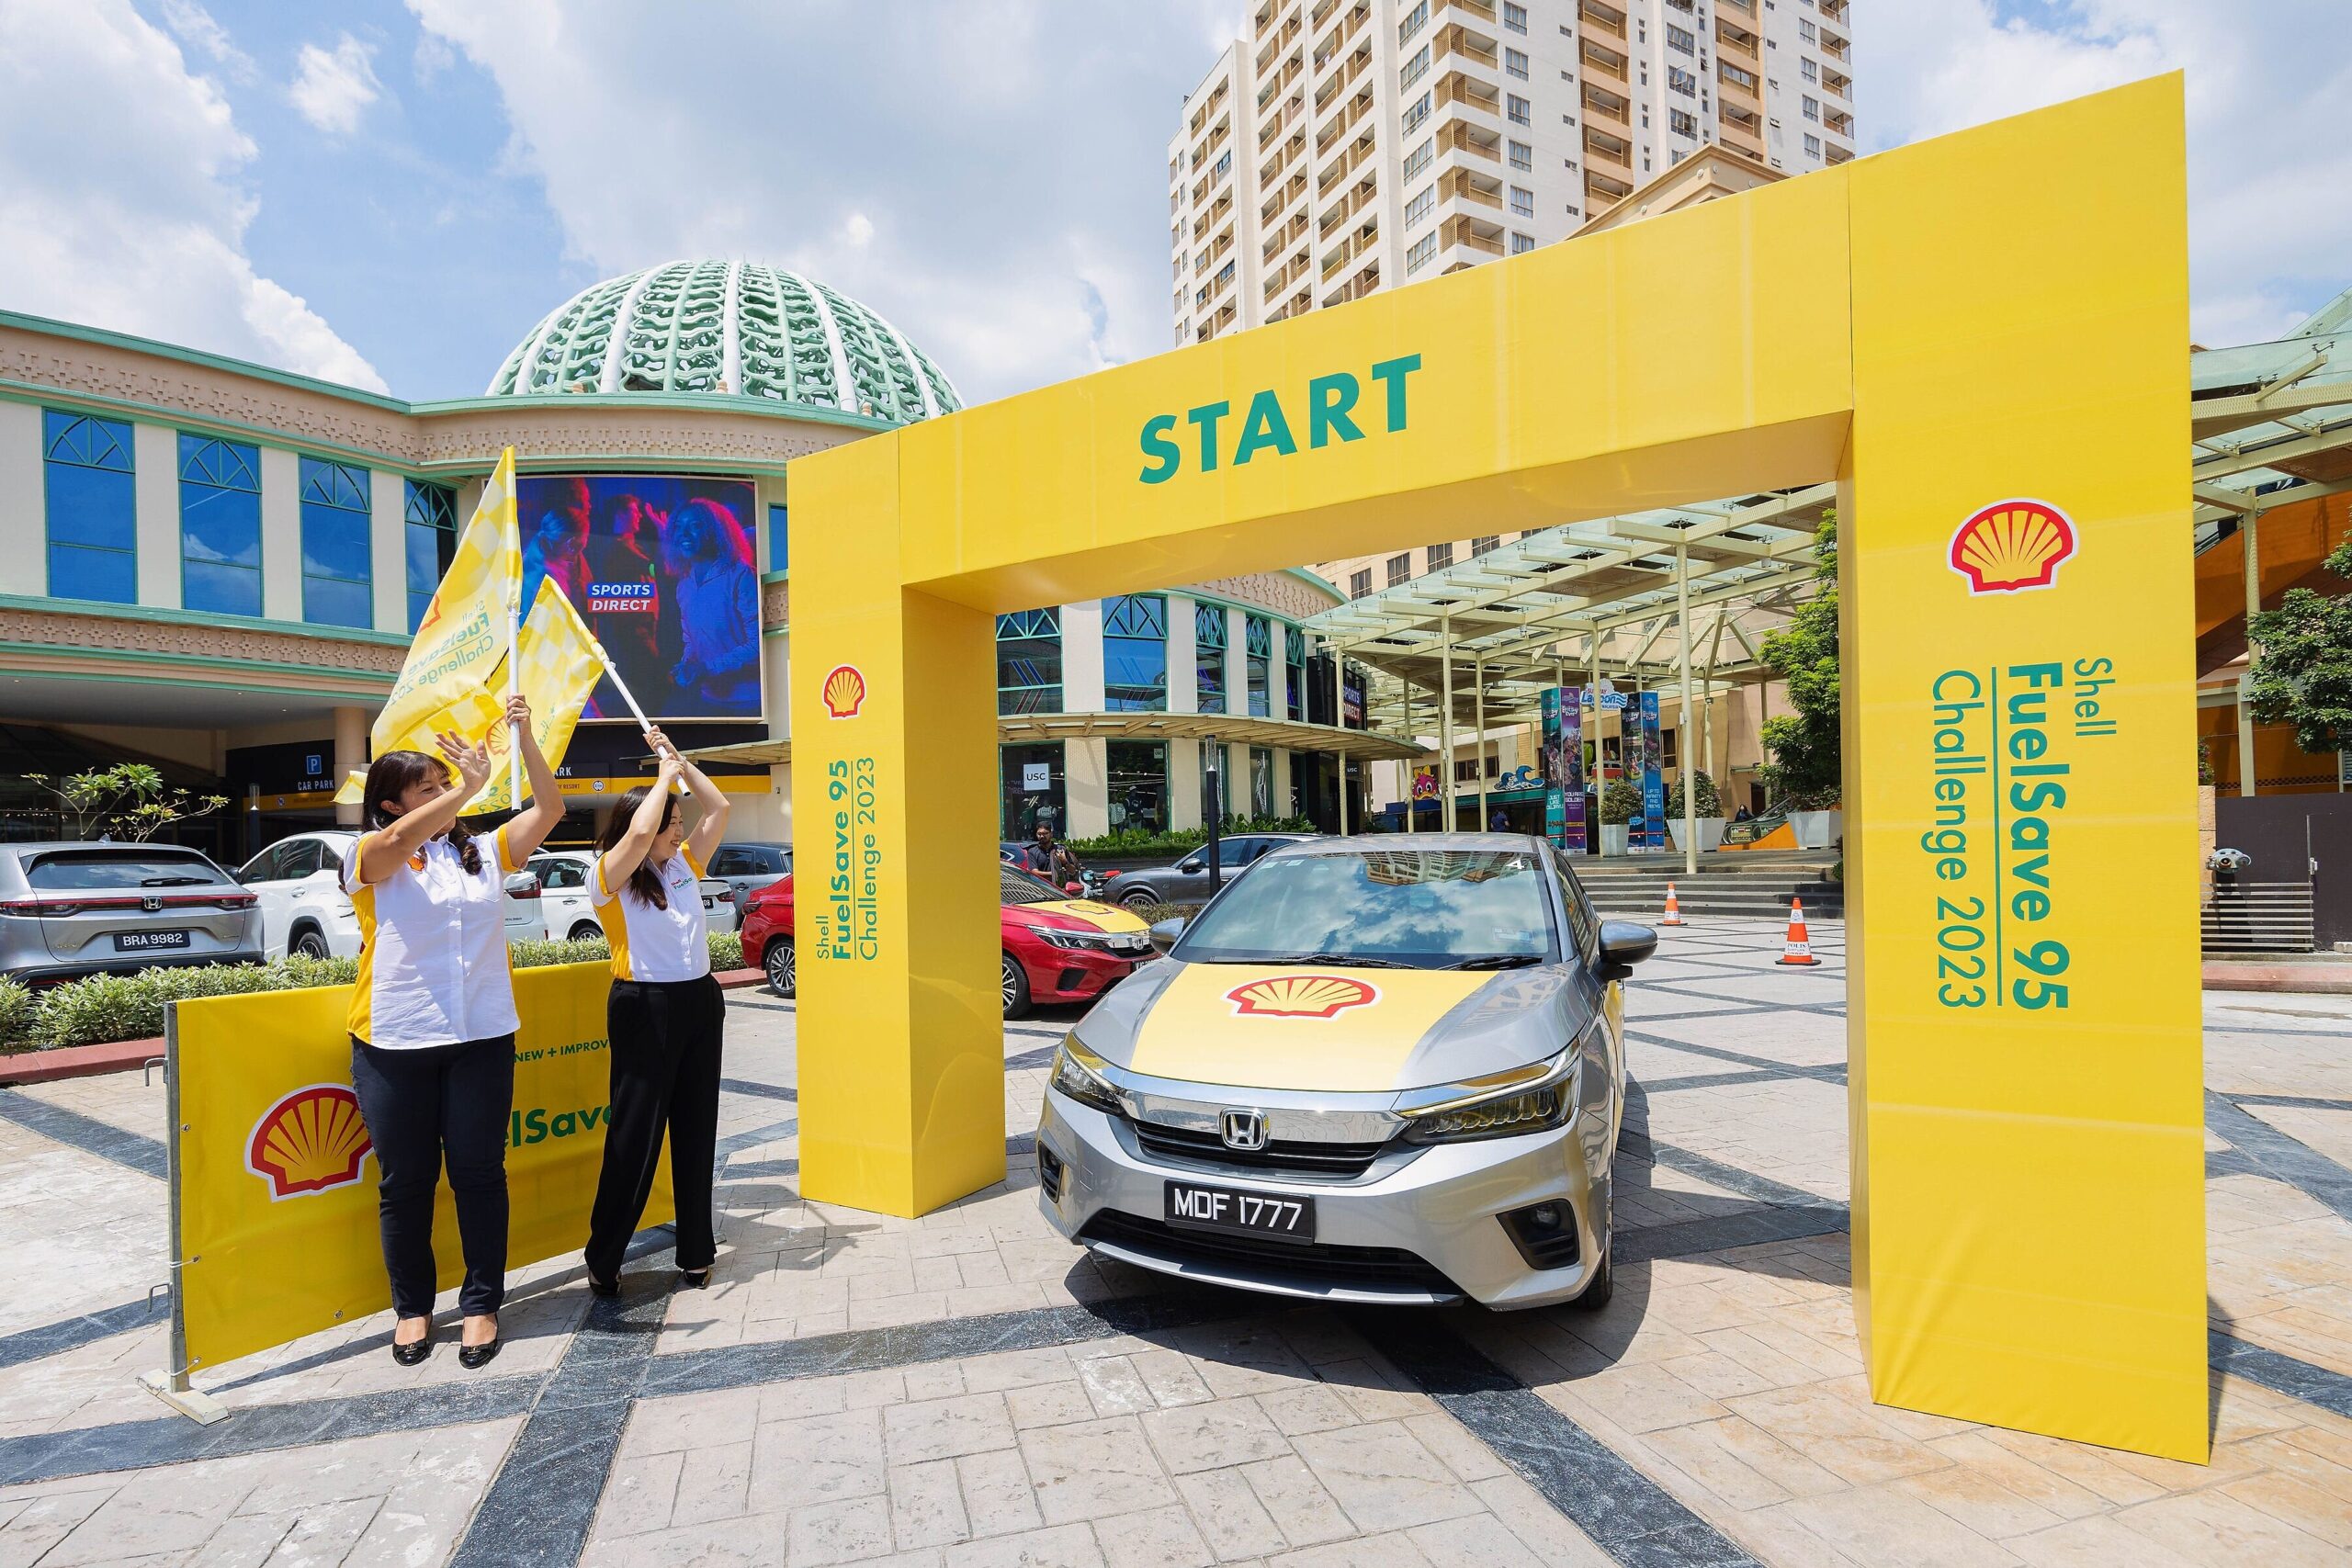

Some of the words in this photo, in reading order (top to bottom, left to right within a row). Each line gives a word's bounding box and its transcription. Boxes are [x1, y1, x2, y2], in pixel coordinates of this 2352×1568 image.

[1139, 353, 1421, 484] START
[592, 584, 650, 595] SPORTS
[592, 600, 650, 611] DIRECT
[2074, 658, 2117, 737] Shell
[297, 782, 311, 790] CAR
[314, 780, 334, 789] PARK
[829, 760, 848, 801] 95
[857, 757, 876, 825] 2023
[1026, 773, 1046, 781] USC
[1920, 670, 1986, 881] Challenge
[2007, 662, 2070, 921] FuelSave
[830, 811, 851, 960] FuelSave
[858, 834, 881, 961] Challenge
[122, 935, 149, 946] BRA
[150, 932, 184, 944] 9982
[816, 915, 830, 959] Shell
[1937, 897, 1986, 1008] 2023
[2012, 940, 2070, 1010] 95
[514, 1049, 545, 1063] NEW
[1174, 1188, 1231, 1221] MDF
[1238, 1196, 1303, 1231] 1777
